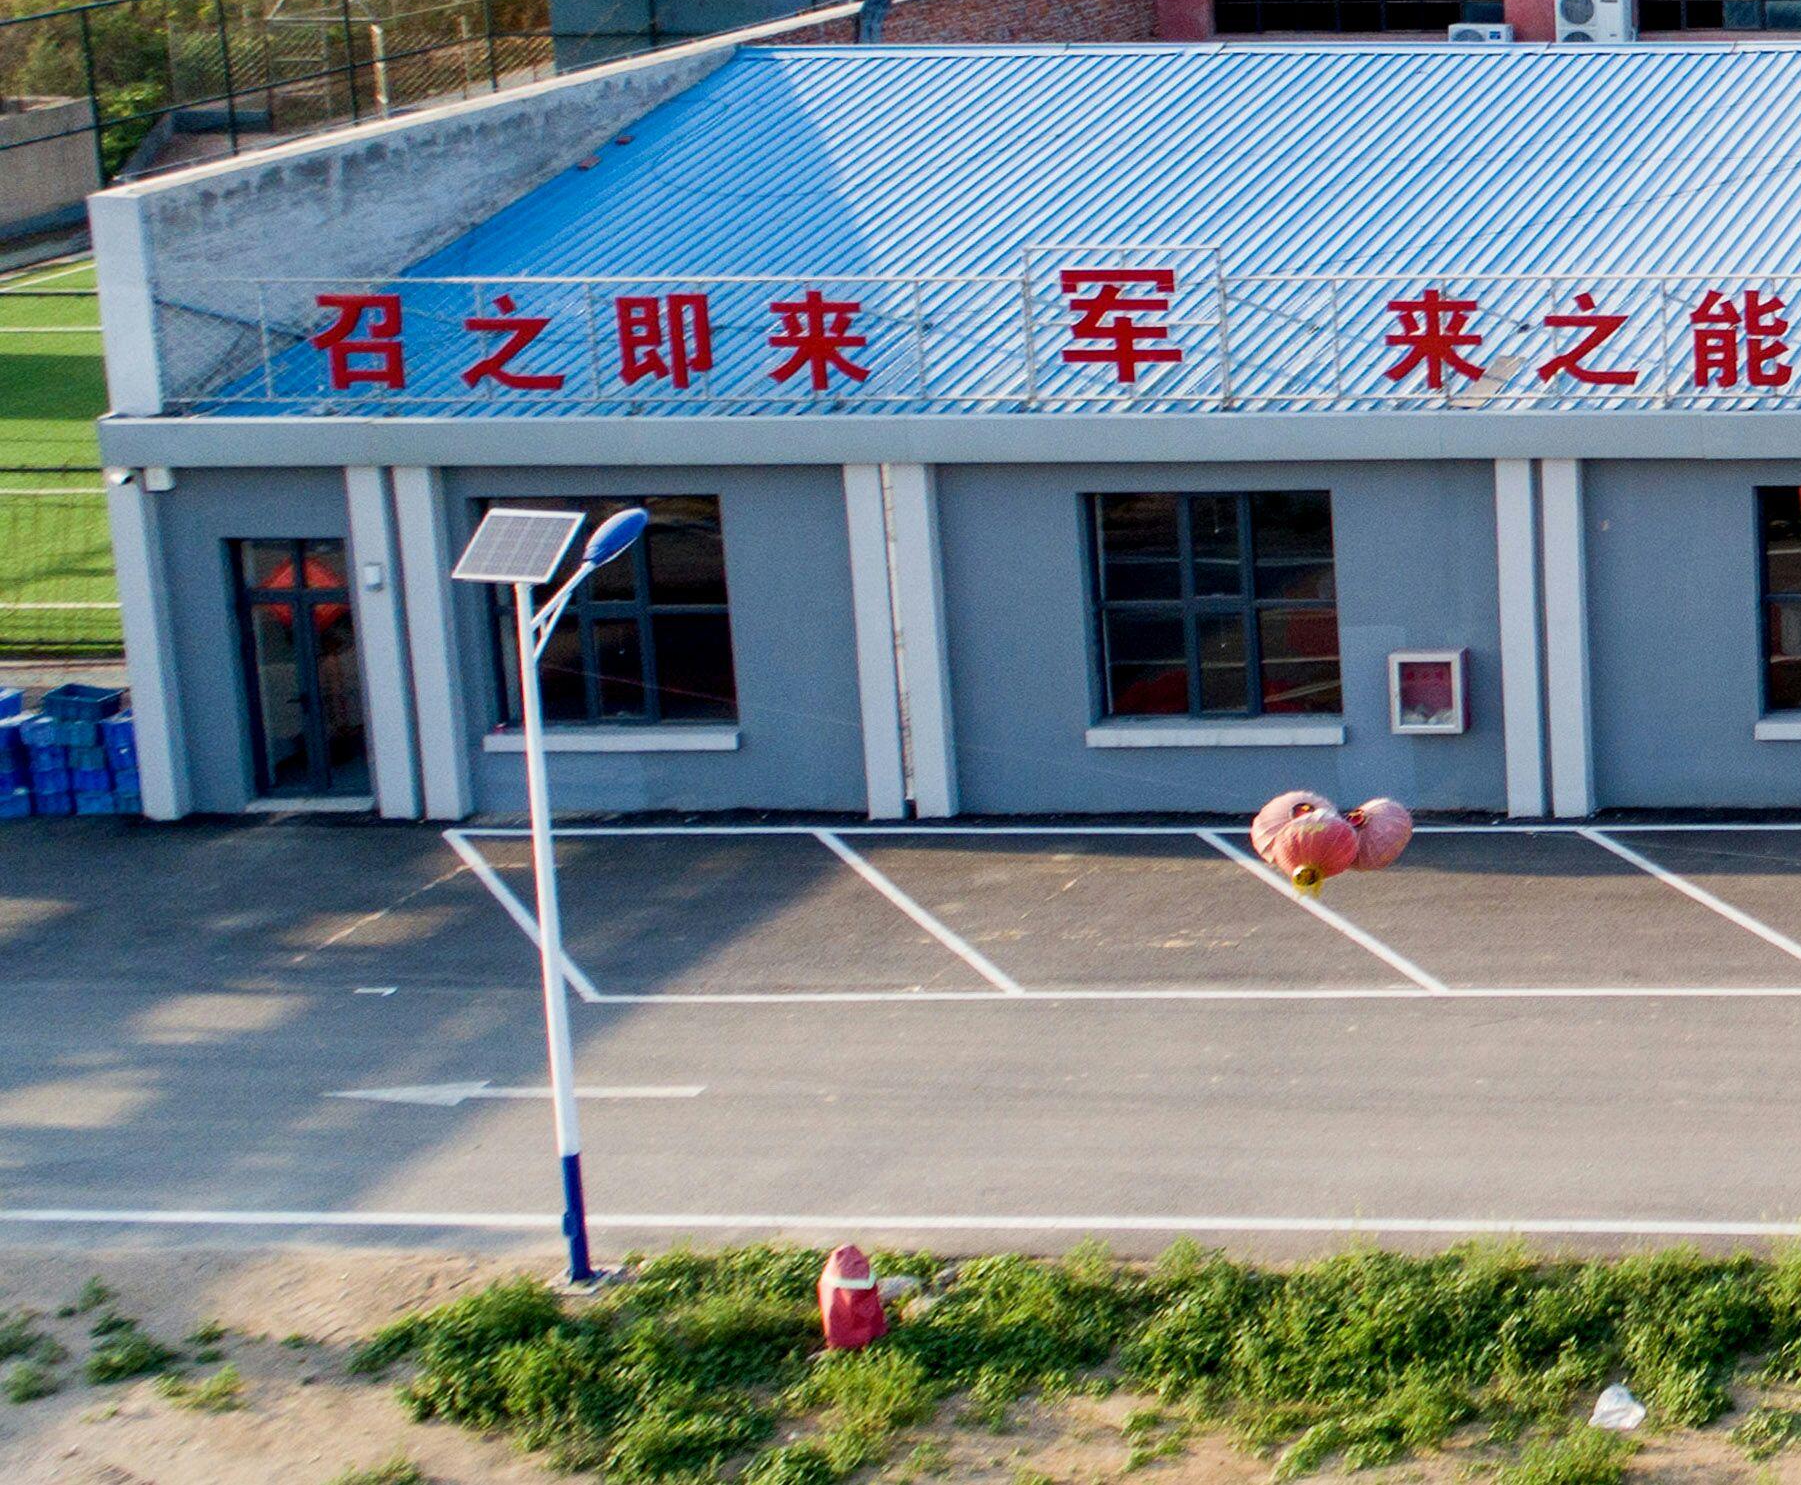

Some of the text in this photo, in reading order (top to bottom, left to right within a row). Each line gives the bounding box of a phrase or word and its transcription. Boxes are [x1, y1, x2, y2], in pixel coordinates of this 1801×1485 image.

[314, 291, 870, 390] 召之即来
[1062, 269, 1183, 383] 军
